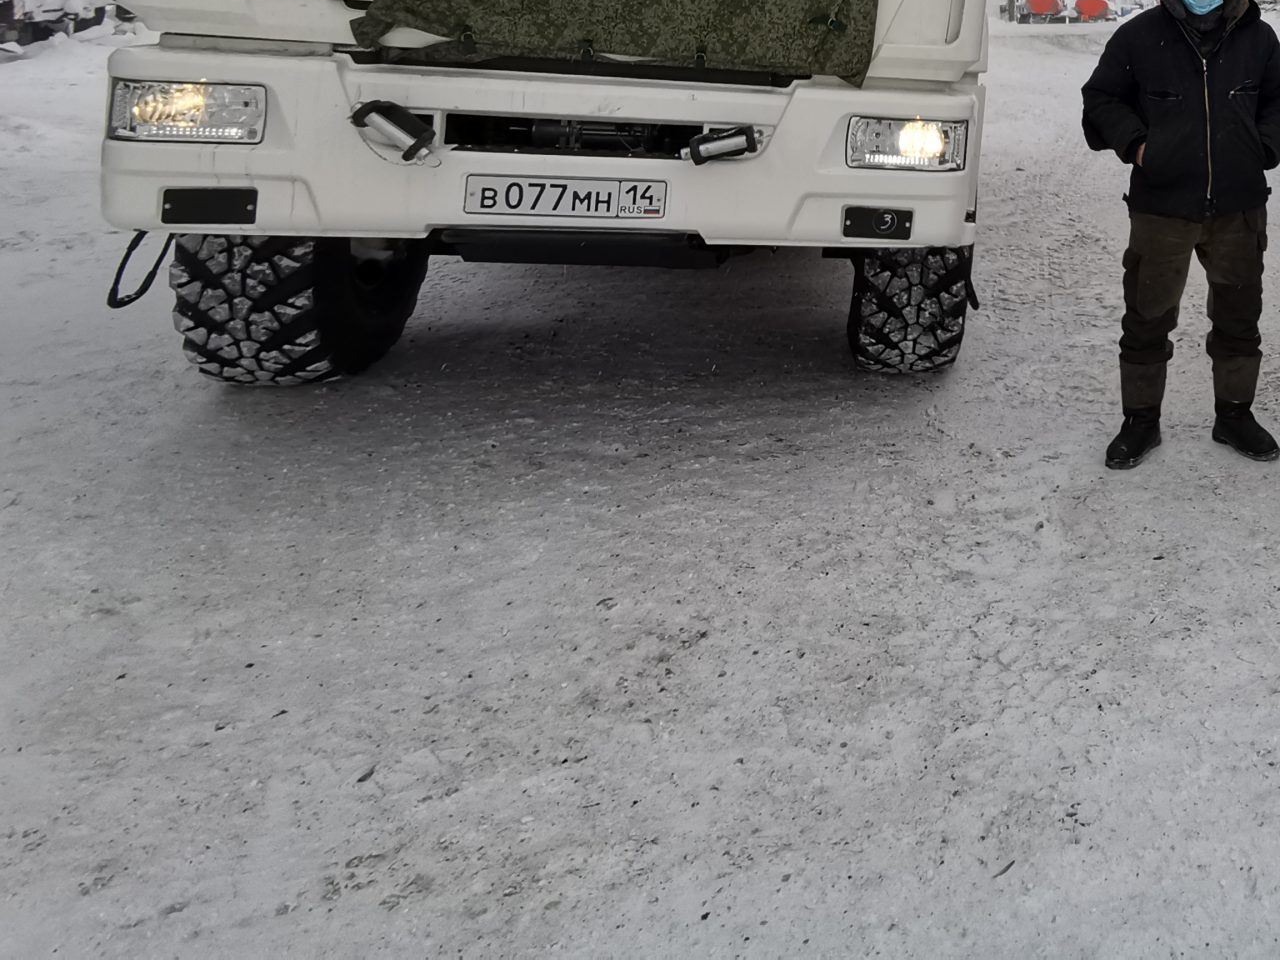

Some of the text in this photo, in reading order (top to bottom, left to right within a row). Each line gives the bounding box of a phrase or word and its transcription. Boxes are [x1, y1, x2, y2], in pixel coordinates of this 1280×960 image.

[479, 182, 654, 213] В077МН 14
[620, 206, 643, 215] RUS
[880, 214, 892, 229] 3
